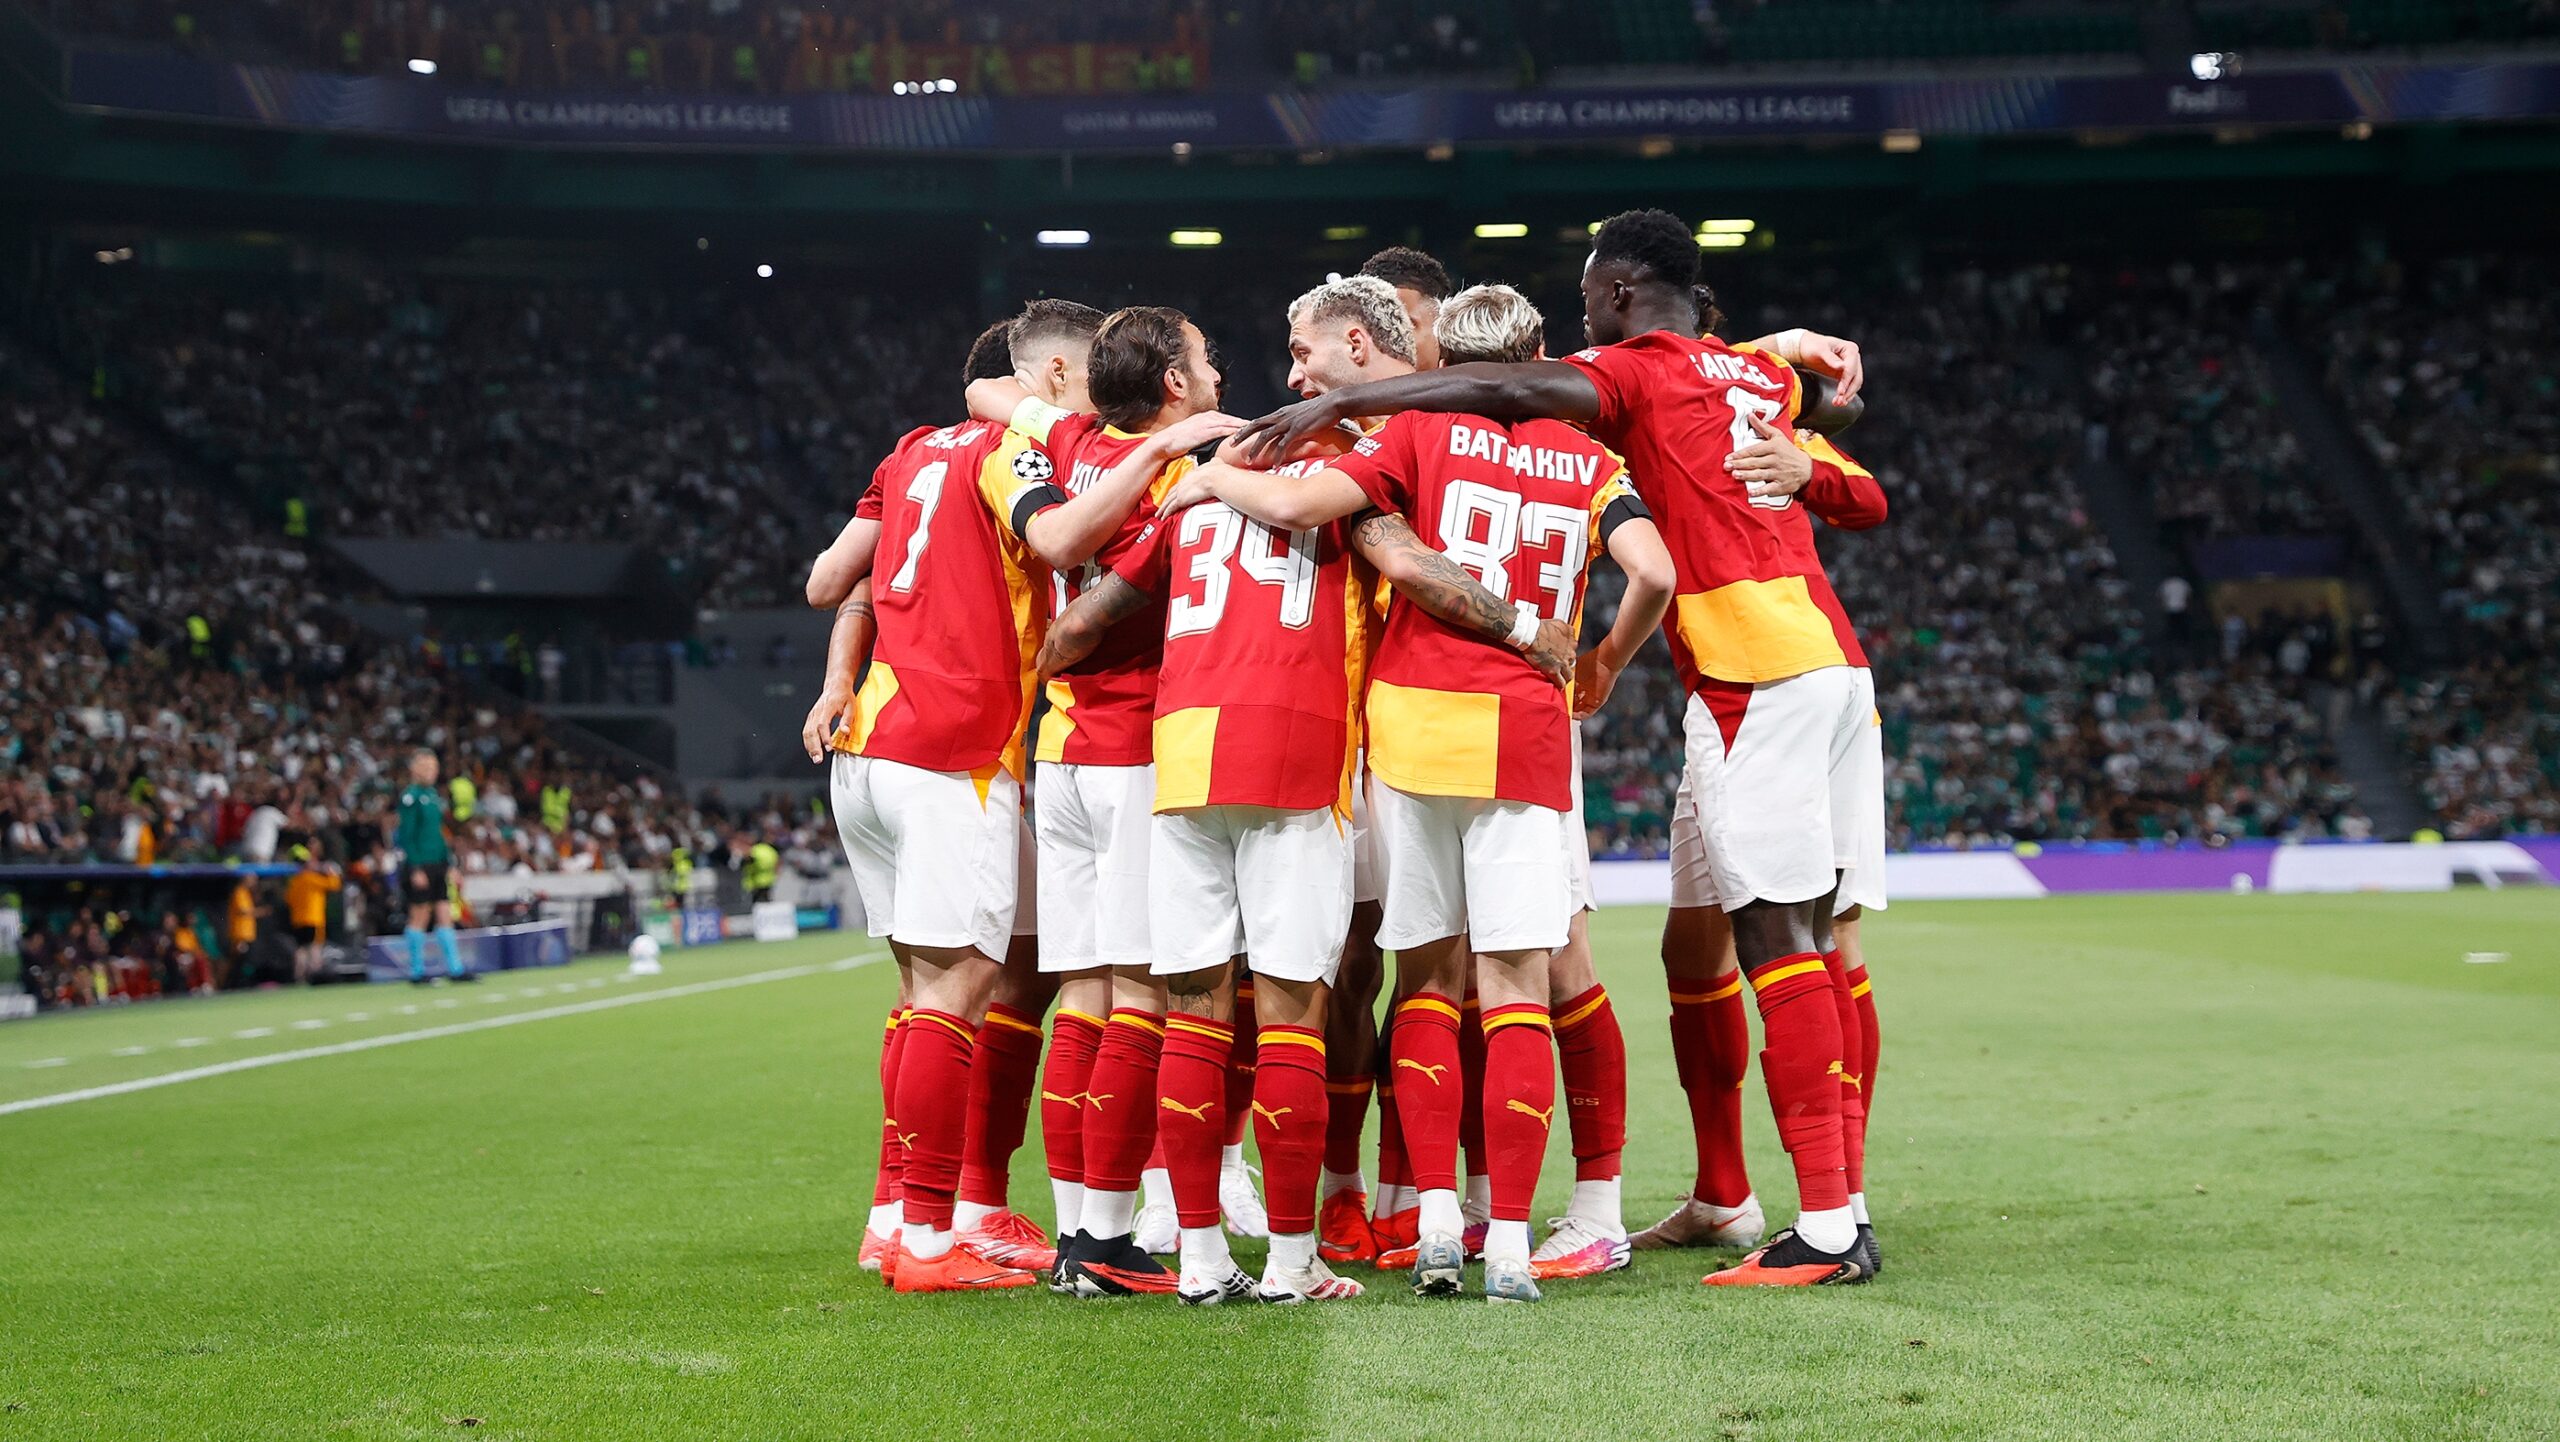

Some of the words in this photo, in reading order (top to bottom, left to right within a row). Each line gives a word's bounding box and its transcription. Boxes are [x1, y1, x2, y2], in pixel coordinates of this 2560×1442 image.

[446, 98, 510, 122] UEFA
[515, 101, 680, 129] CHAMPIONS
[685, 104, 792, 132] LEAGUE
[1495, 102, 1568, 127] UEFA
[1572, 99, 1740, 126] CHAMPIONS
[1745, 96, 1853, 124] LEAGUE
[890, 461, 949, 593] 7
[1438, 479, 1590, 626] 83
[1167, 502, 1320, 641] 34
[1573, 1097, 1600, 1106] GS
